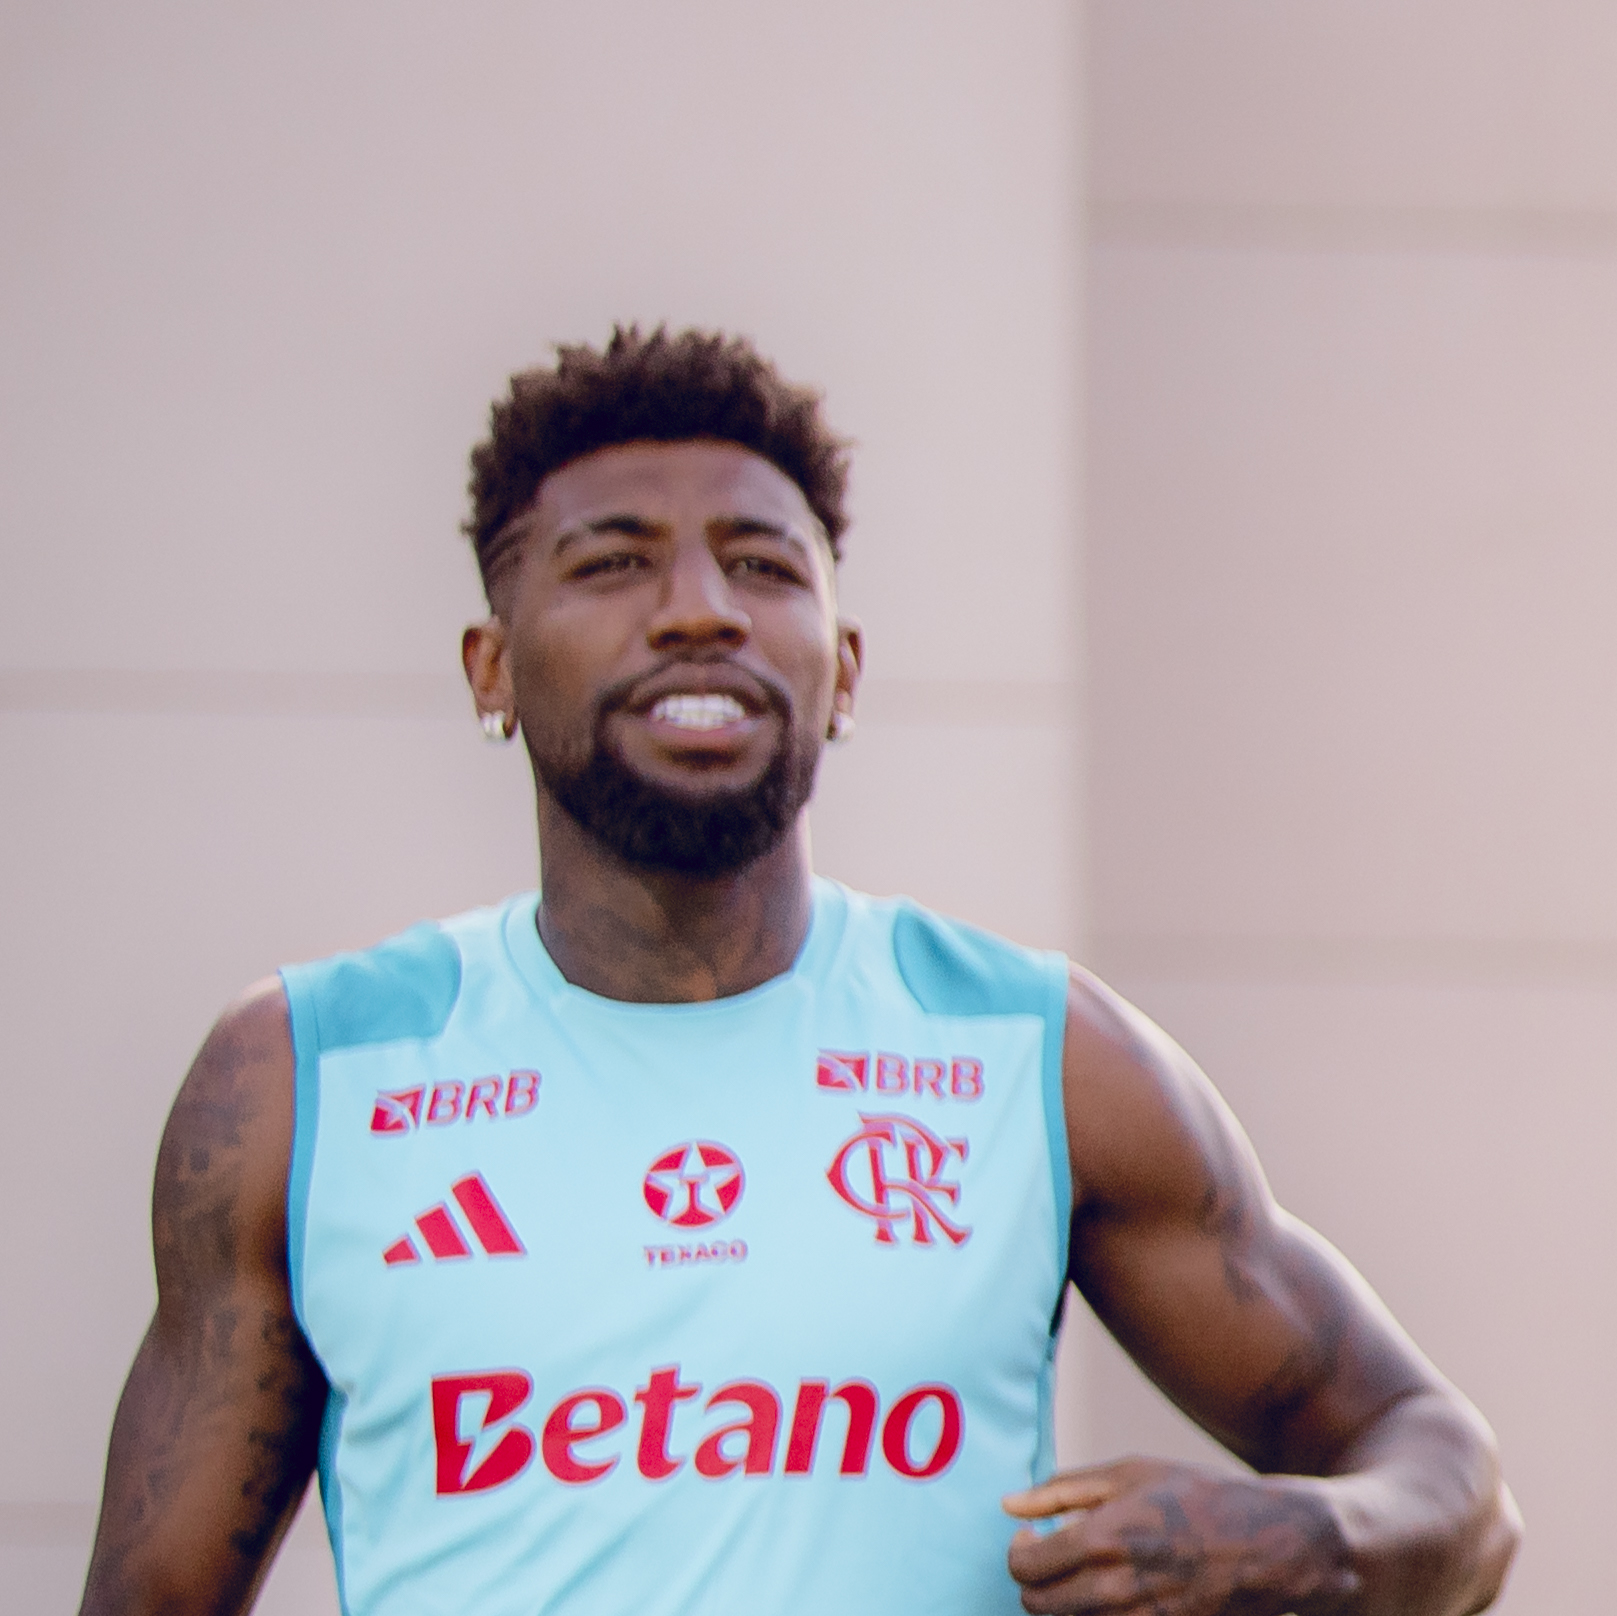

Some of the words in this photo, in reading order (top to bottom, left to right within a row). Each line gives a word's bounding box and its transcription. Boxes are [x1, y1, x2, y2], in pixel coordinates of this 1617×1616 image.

[427, 1069, 542, 1127] BRB
[876, 1055, 985, 1101] BRB
[643, 1239, 748, 1268] TEXACO
[430, 1365, 966, 1499] Betano
